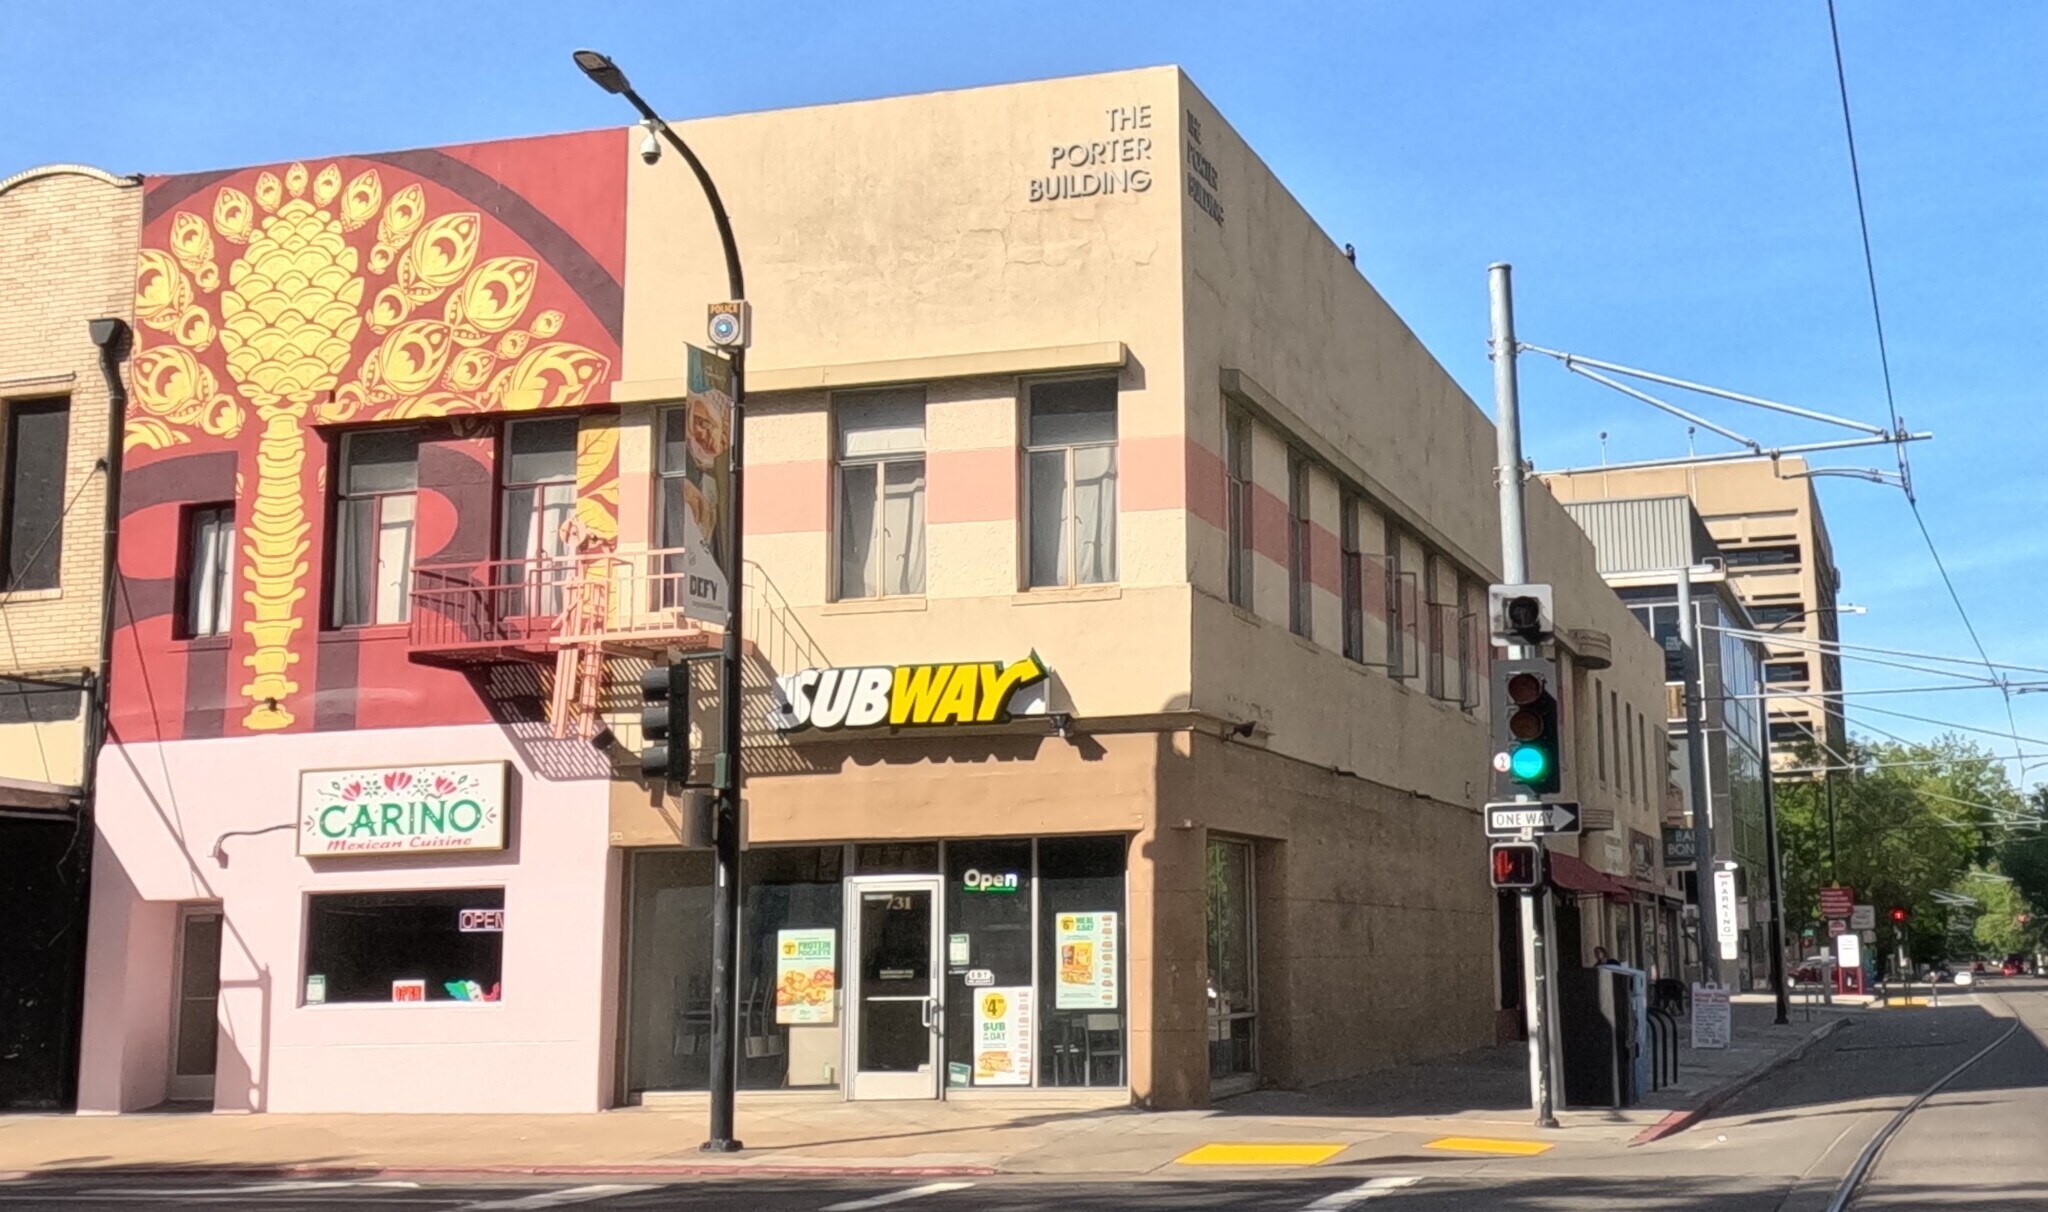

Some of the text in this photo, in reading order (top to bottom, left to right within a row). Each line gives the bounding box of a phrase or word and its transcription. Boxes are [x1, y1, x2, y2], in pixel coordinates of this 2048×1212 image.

[1106, 105, 1152, 132] THE
[1051, 137, 1152, 169] PORTER
[1029, 169, 1153, 203] BUILDING
[709, 304, 738, 314] POLICE
[689, 574, 718, 601] DEFY
[776, 656, 1041, 730] SUBWAY
[1496, 812, 1554, 826] ONE WAY
[327, 836, 472, 851] Mexican Cuisine
[1675, 831, 1696, 842] BAI
[1668, 843, 1696, 855] BON
[963, 868, 1018, 892] Open
[885, 896, 912, 911] 731
[1720, 880, 1732, 934] PARKING
[462, 911, 504, 929] OPEN
[983, 1022, 1006, 1031] SUB
